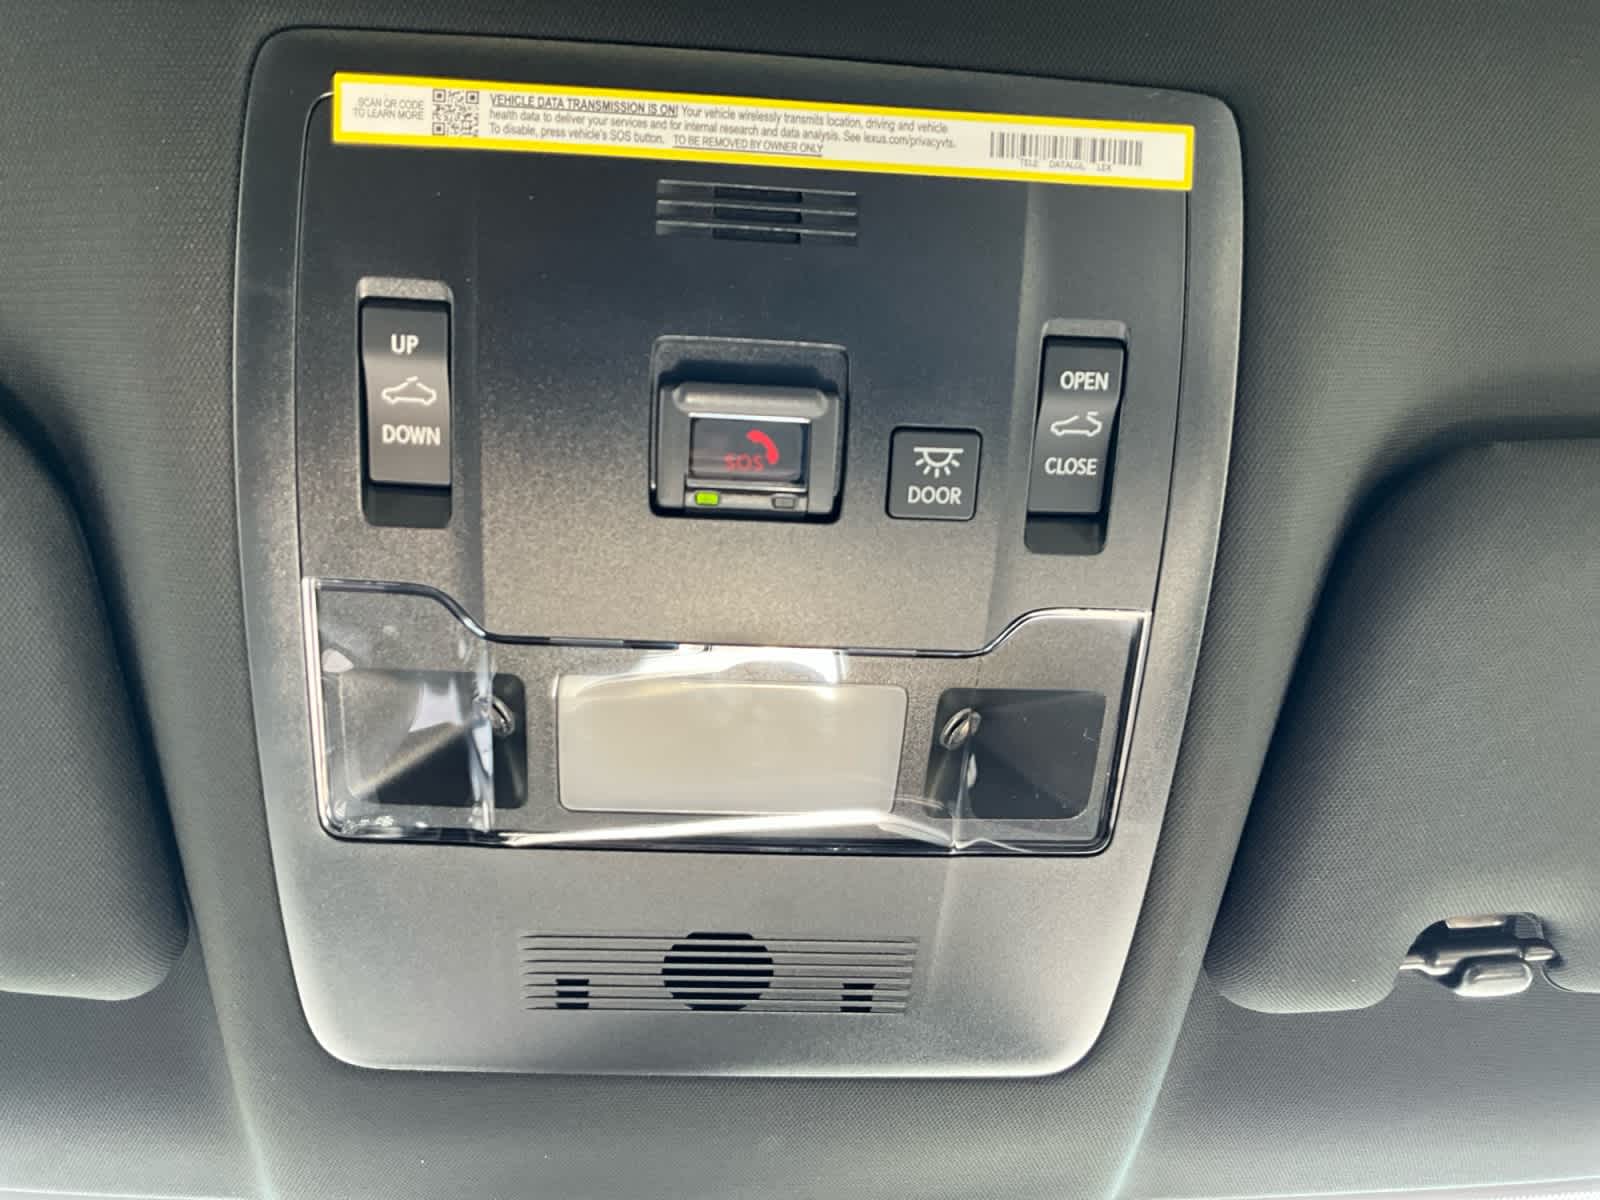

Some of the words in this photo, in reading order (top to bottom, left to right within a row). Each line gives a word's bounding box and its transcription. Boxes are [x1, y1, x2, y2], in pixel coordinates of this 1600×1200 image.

[358, 96, 381, 107] SCAN
[383, 98, 397, 108] QR
[399, 99, 424, 109] CODE
[489, 93, 534, 108] VEHICLE
[538, 96, 564, 109] DATA
[567, 98, 645, 114] TRANSMISSION
[648, 102, 657, 114] IS
[659, 103, 678, 116] ON!
[681, 104, 702, 115] Your
[705, 106, 736, 119] vehicle
[739, 108, 782, 124] wirelessly
[784, 112, 823, 125] transmits
[826, 115, 863, 129] location,
[866, 117, 896, 132] driving
[898, 119, 914, 131] and
[352, 107, 365, 118] TO
[367, 108, 395, 118] LEARN
[397, 109, 424, 120] MORE
[489, 109, 518, 121] health
[520, 110, 540, 122] data
[543, 112, 553, 122] to
[555, 112, 585, 124] deliver
[588, 116, 608, 127] your
[611, 117, 647, 129] services
[650, 118, 667, 130] and
[670, 119, 682, 130] for
[685, 119, 717, 132] internal
[720, 121, 758, 136] research
[761, 124, 778, 137] and
[780, 125, 800, 138] data
[802, 129, 840, 143] analysis.
[843, 130, 861, 142] See
[489, 122, 500, 134] To
[503, 124, 538, 138] disable,
[541, 127, 566, 138] press
[569, 126, 607, 140] vehicle's
[609, 129, 631, 142] SOS
[634, 130, 664, 144] button.
[673, 133, 686, 147] TO
[688, 135, 700, 147] BE
[702, 135, 748, 149] REMOVED
[750, 138, 761, 150] BY
[763, 139, 797, 151] OWNER
[800, 142, 823, 153] ONLY
[390, 333, 419, 354] UP
[1060, 371, 1109, 391] OPEN
[381, 424, 441, 446] DOWN
[723, 452, 765, 472] SOS
[1044, 457, 1098, 476] CLOSE
[907, 486, 962, 505] DOOR
